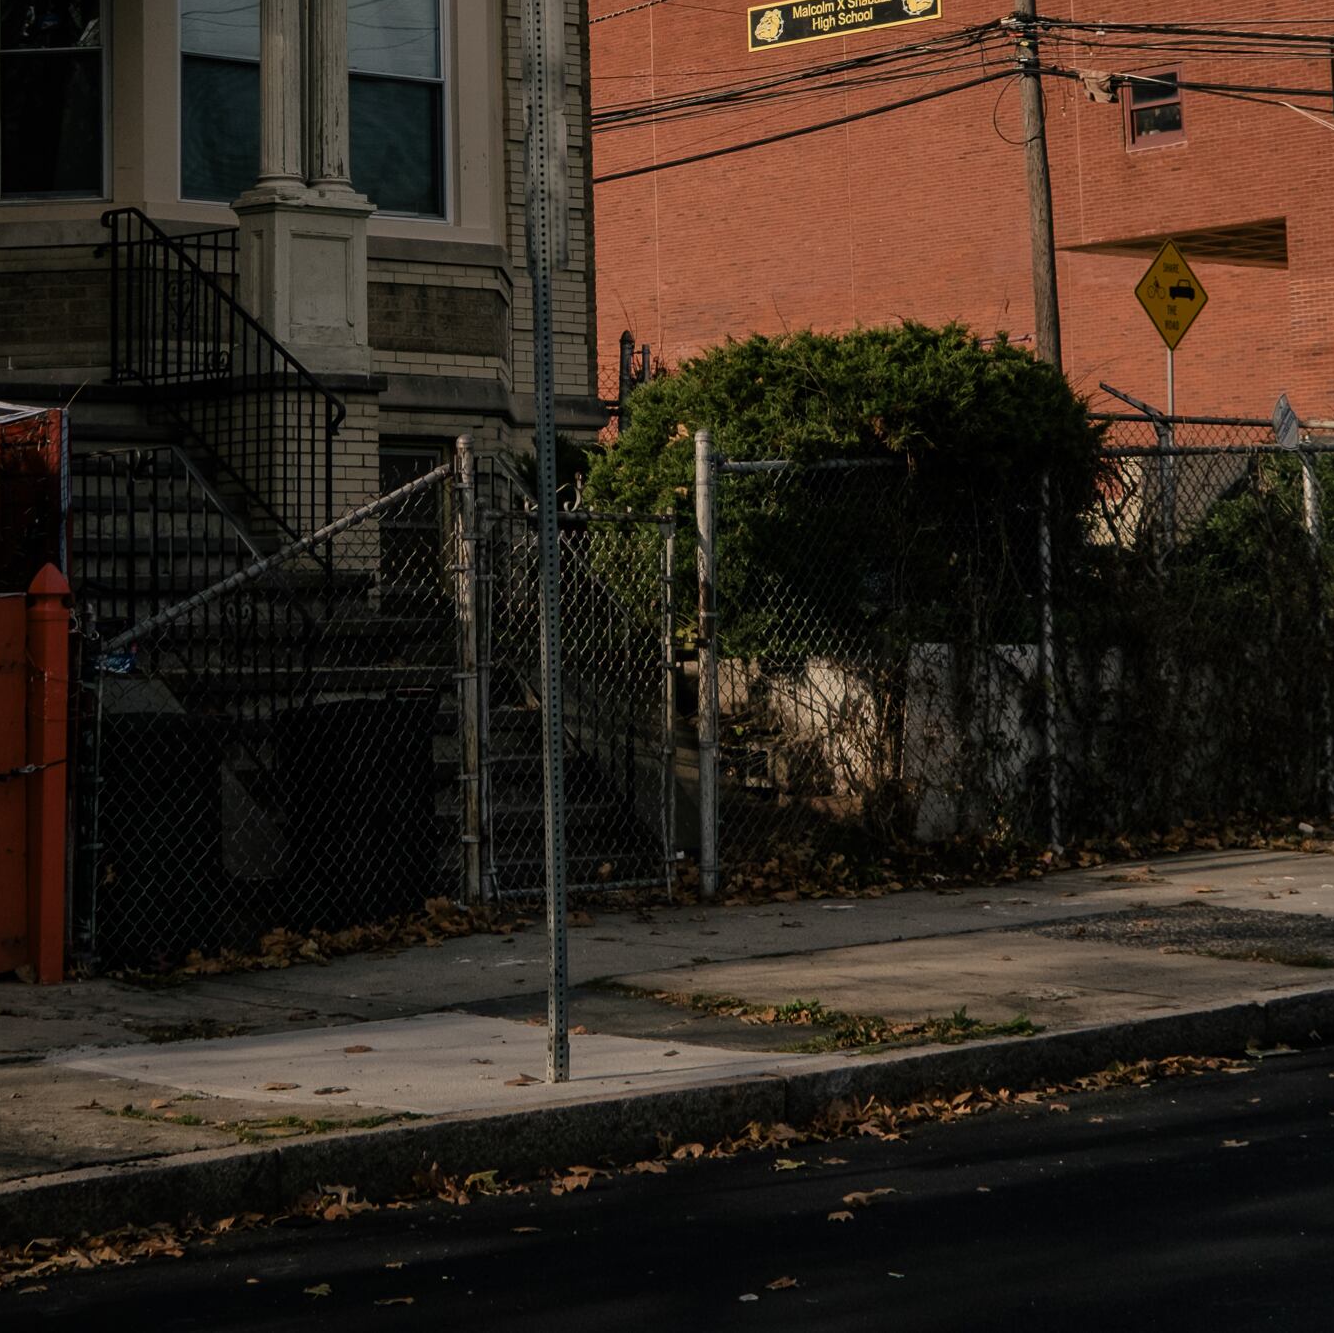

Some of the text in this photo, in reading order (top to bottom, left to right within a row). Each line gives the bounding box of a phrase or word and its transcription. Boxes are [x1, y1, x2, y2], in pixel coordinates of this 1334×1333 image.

[792, 3, 835, 19] Malcolm
[812, 7, 873, 31] High School
